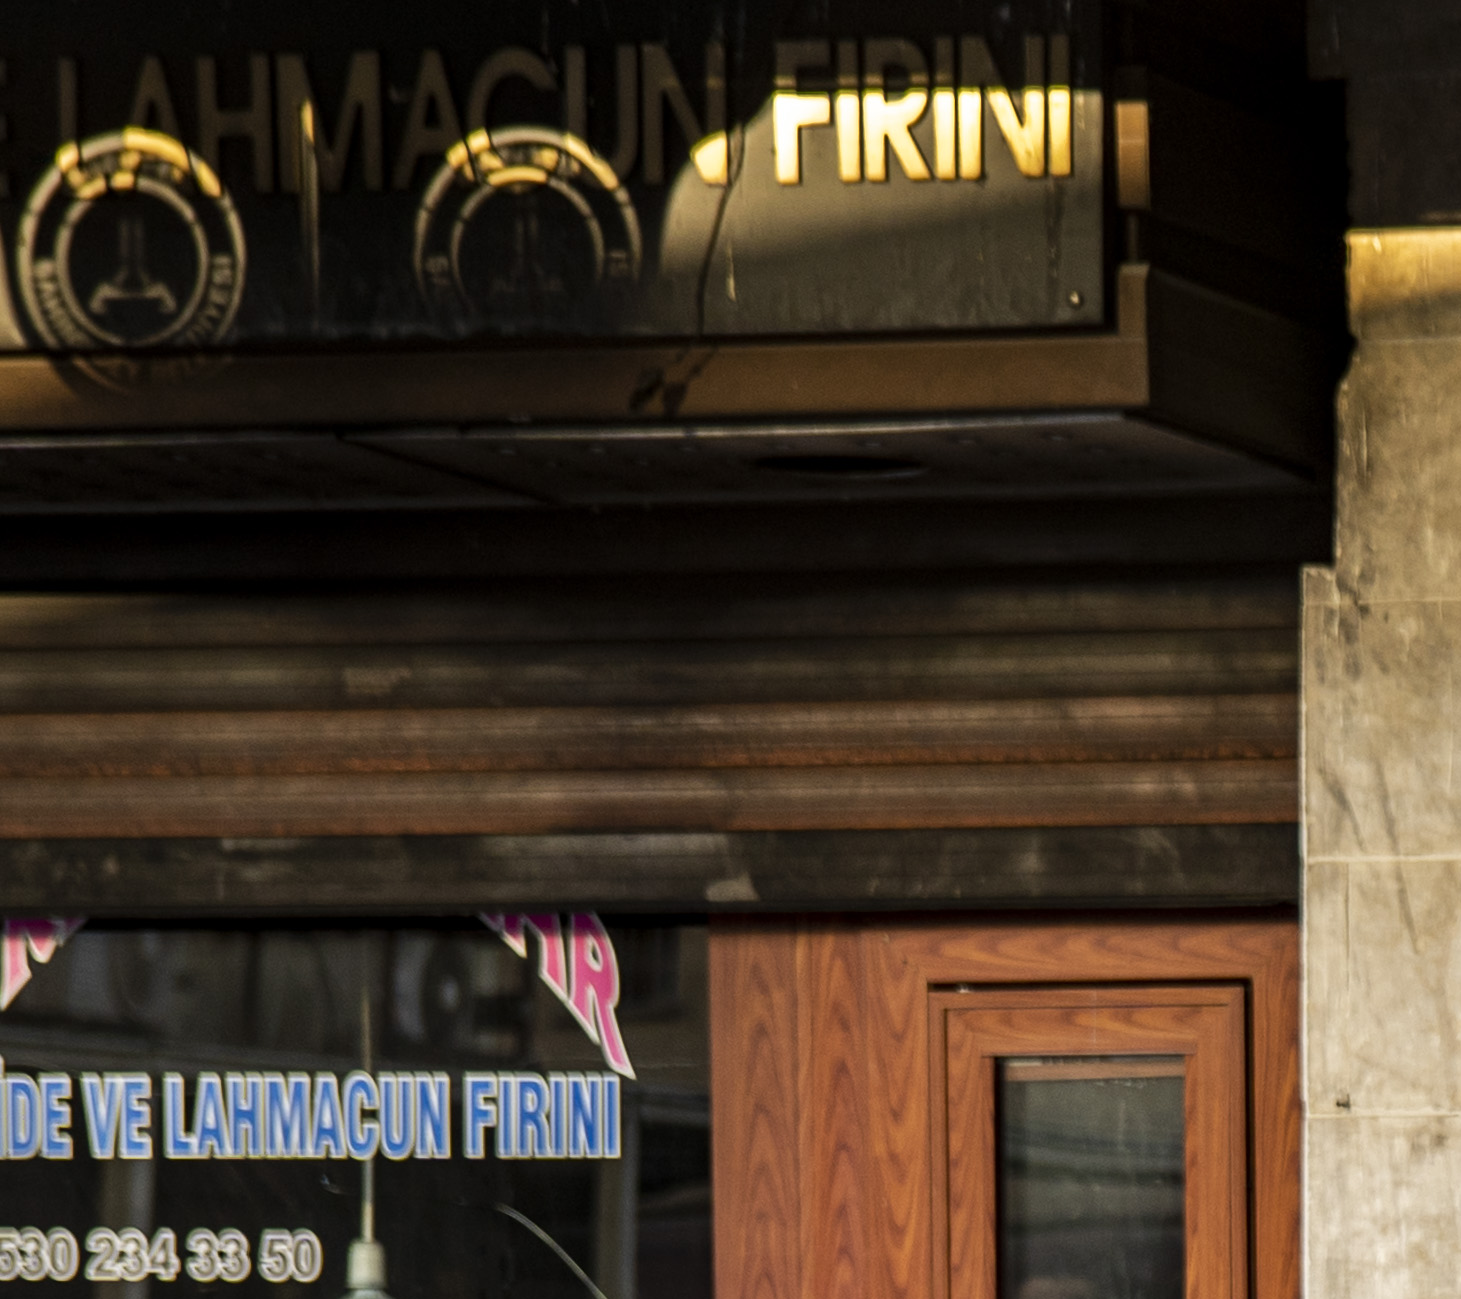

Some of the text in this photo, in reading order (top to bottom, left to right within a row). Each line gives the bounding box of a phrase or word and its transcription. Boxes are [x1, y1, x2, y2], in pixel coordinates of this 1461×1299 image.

[57, 40, 728, 195] LAHMACUN
[773, 34, 1072, 184] FIRINI
[0, 1058, 621, 1161] DE VE LAHMACUN FIRINI
[84, 1226, 181, 1282] 234
[185, 1227, 251, 1283] 33
[258, 1228, 323, 1283] 50
